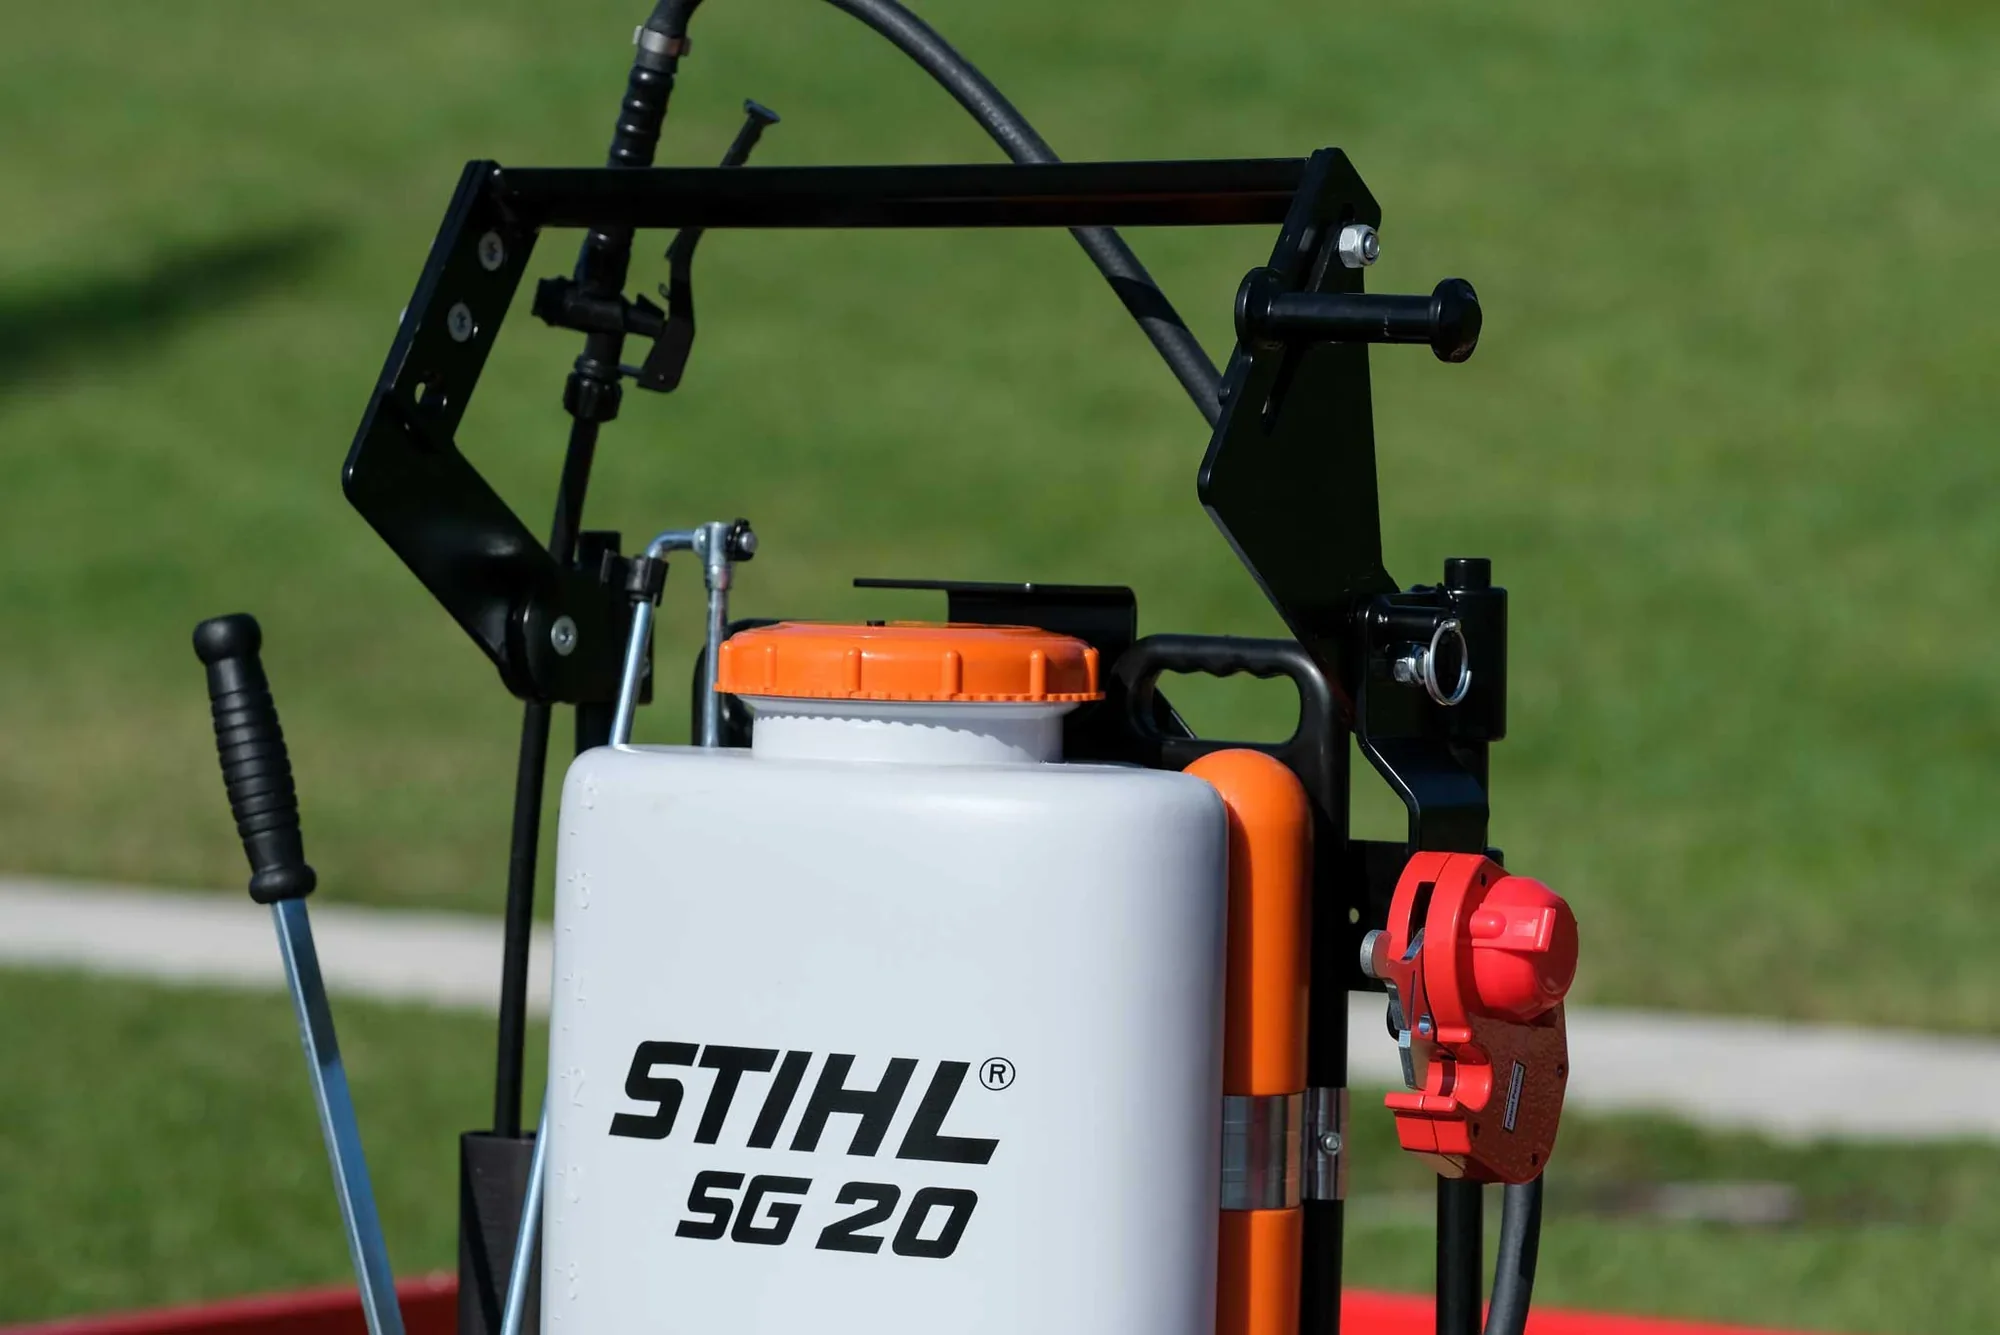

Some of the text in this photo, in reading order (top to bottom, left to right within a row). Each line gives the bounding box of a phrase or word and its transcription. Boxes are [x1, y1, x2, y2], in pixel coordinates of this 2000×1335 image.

[608, 1040, 1001, 1165] STIHL
[674, 1170, 813, 1246] SG
[814, 1181, 979, 1259] 20
